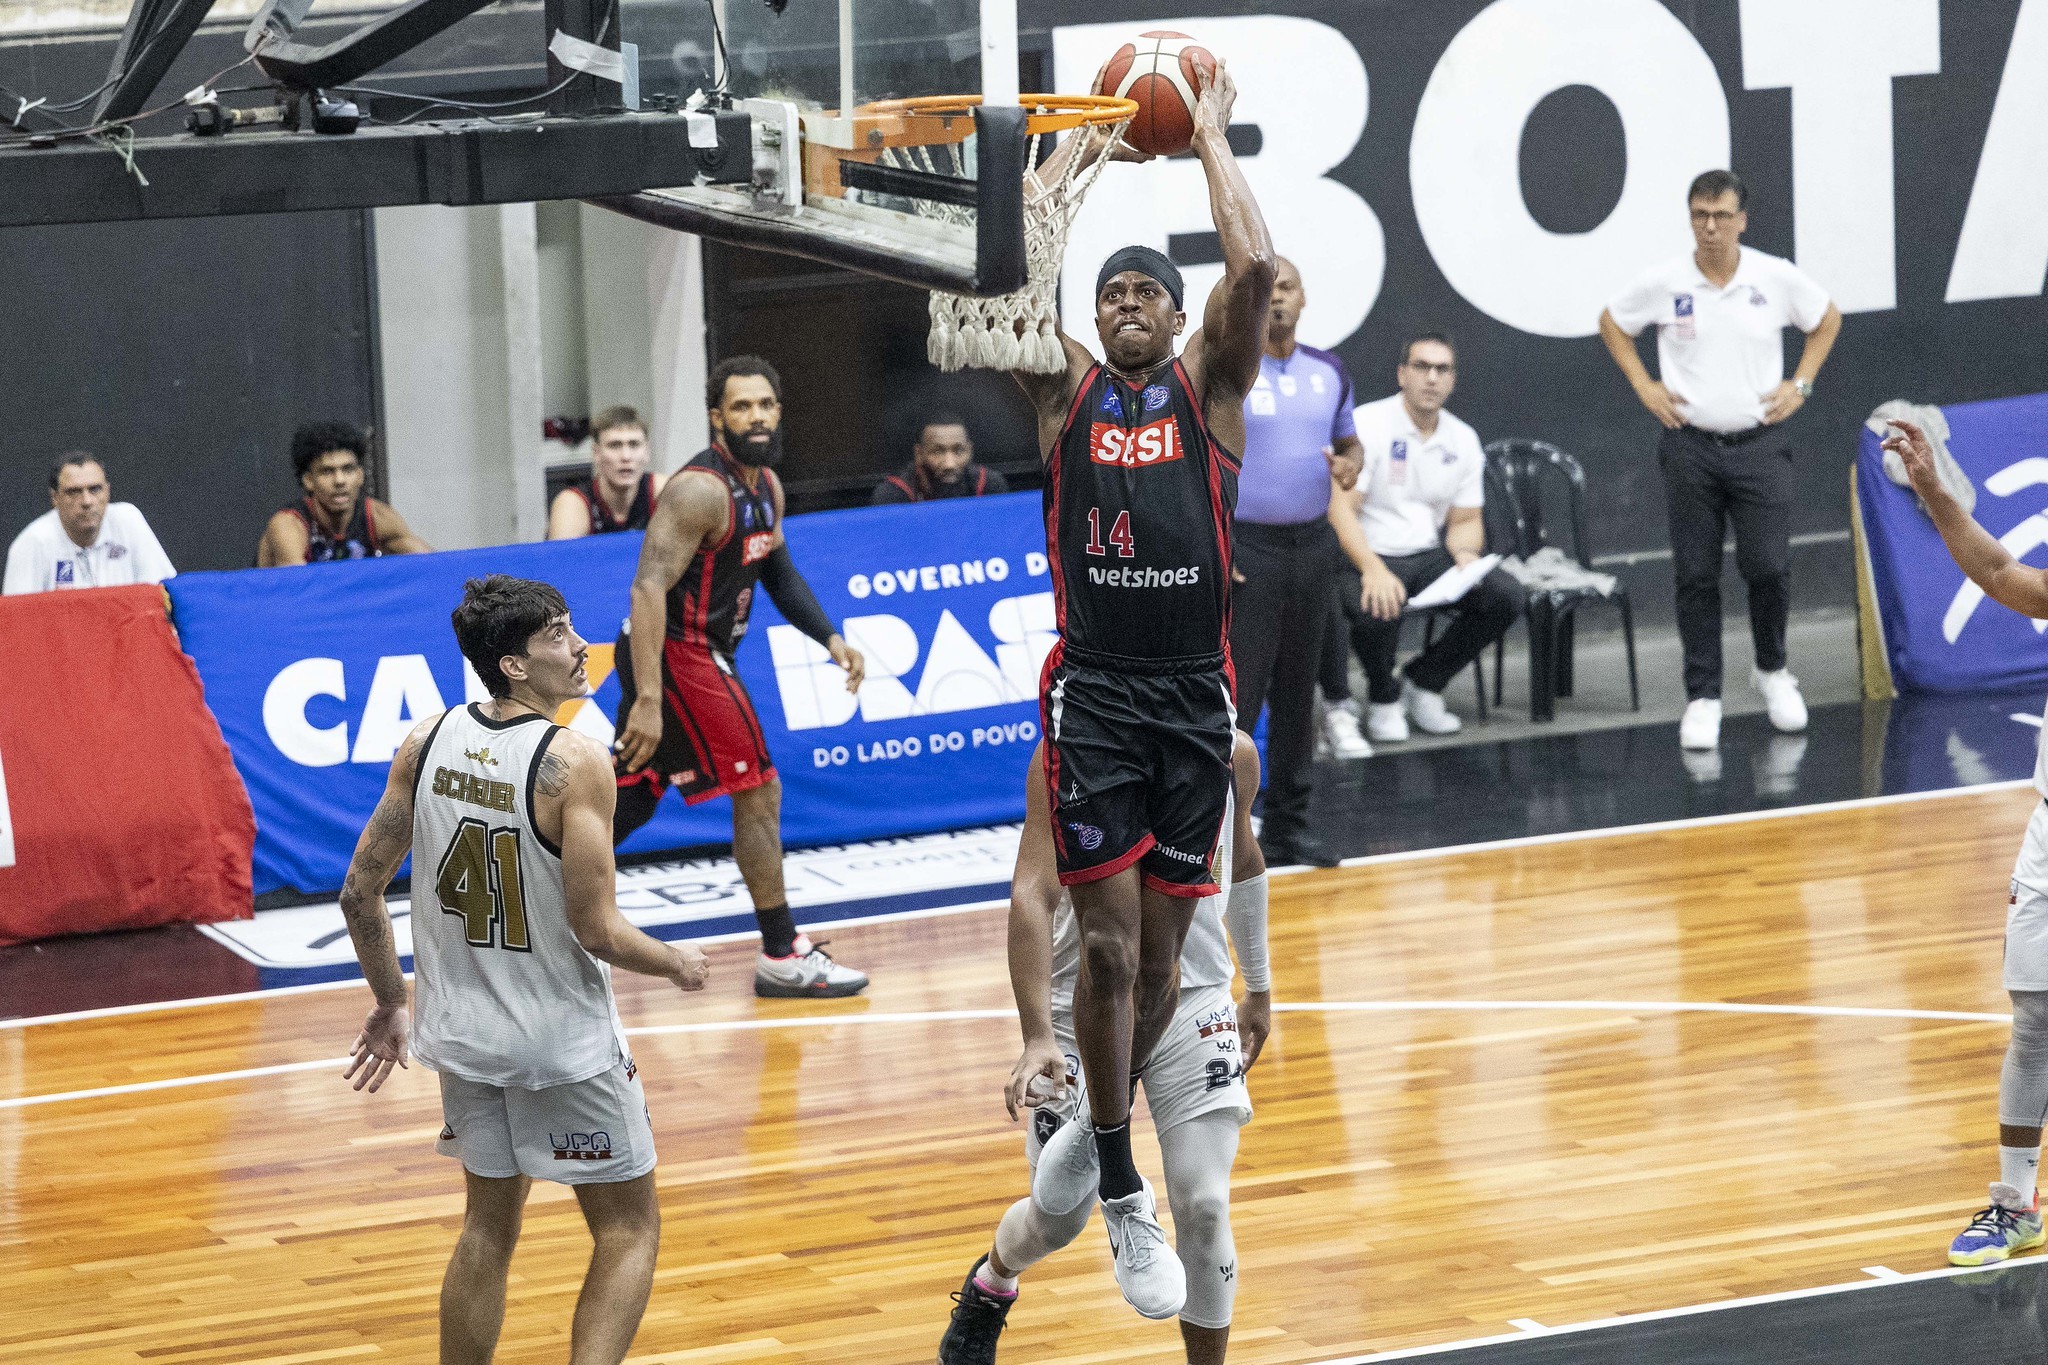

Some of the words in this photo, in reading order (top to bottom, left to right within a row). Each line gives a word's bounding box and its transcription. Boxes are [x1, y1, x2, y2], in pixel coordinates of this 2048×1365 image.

[1097, 423, 1175, 465] SESI
[1086, 507, 1135, 558] 14
[848, 557, 1009, 599] GOVERNO
[1025, 552, 1049, 577] D
[766, 591, 1063, 732] BRAS
[813, 746, 849, 768] DO
[857, 737, 921, 763] LADO
[929, 731, 965, 754] DO
[972, 720, 1037, 748] POVO
[432, 766, 515, 813] SCHEUER
[435, 816, 532, 953] 41
[550, 1131, 612, 1150] UPA
[566, 1151, 601, 1161] PET
